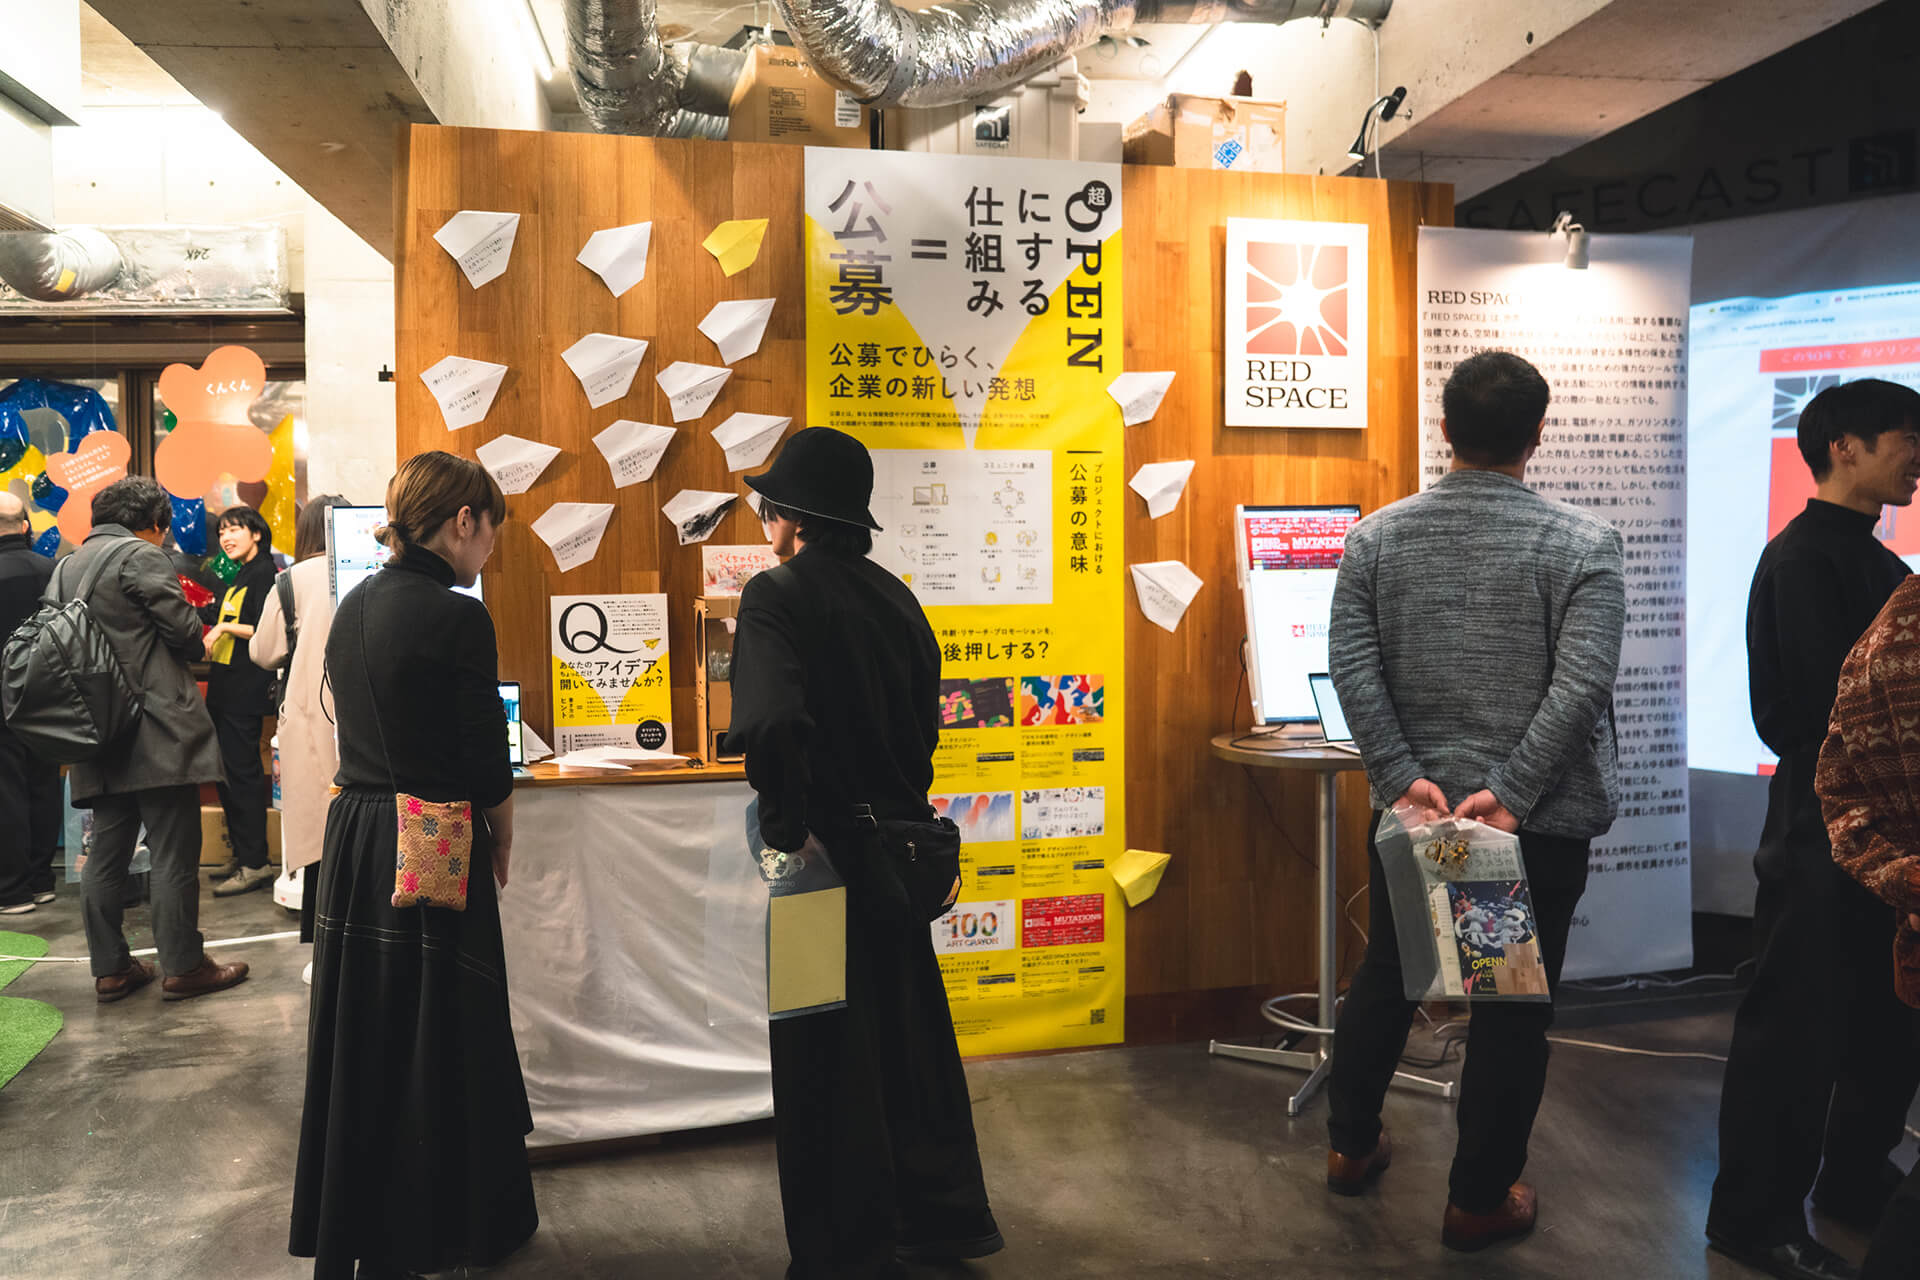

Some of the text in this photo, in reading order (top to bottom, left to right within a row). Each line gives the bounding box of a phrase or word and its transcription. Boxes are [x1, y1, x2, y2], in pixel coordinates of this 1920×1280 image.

[1088, 187, 1105, 206] 超
[828, 180, 893, 316] 公募
[965, 186, 1005, 317] 仕組み
[1016, 189, 1053, 317] にする
[1065, 191, 1102, 373] OPEN
[1427, 290, 1466, 305] RED
[828, 343, 996, 370] 公募でひらく、
[1246, 360, 1311, 382] RED
[206, 379, 251, 395] くんくん
[828, 373, 1036, 401] 企業の新しい発想
[1246, 386, 1348, 409] SPACE
[1070, 464, 1088, 573] 公募の意味
[1094, 464, 1103, 574] プロジェクトにおける
[559, 602, 643, 654] Q
[594, 660, 663, 675] アイデア、
[950, 912, 998, 938] 100
